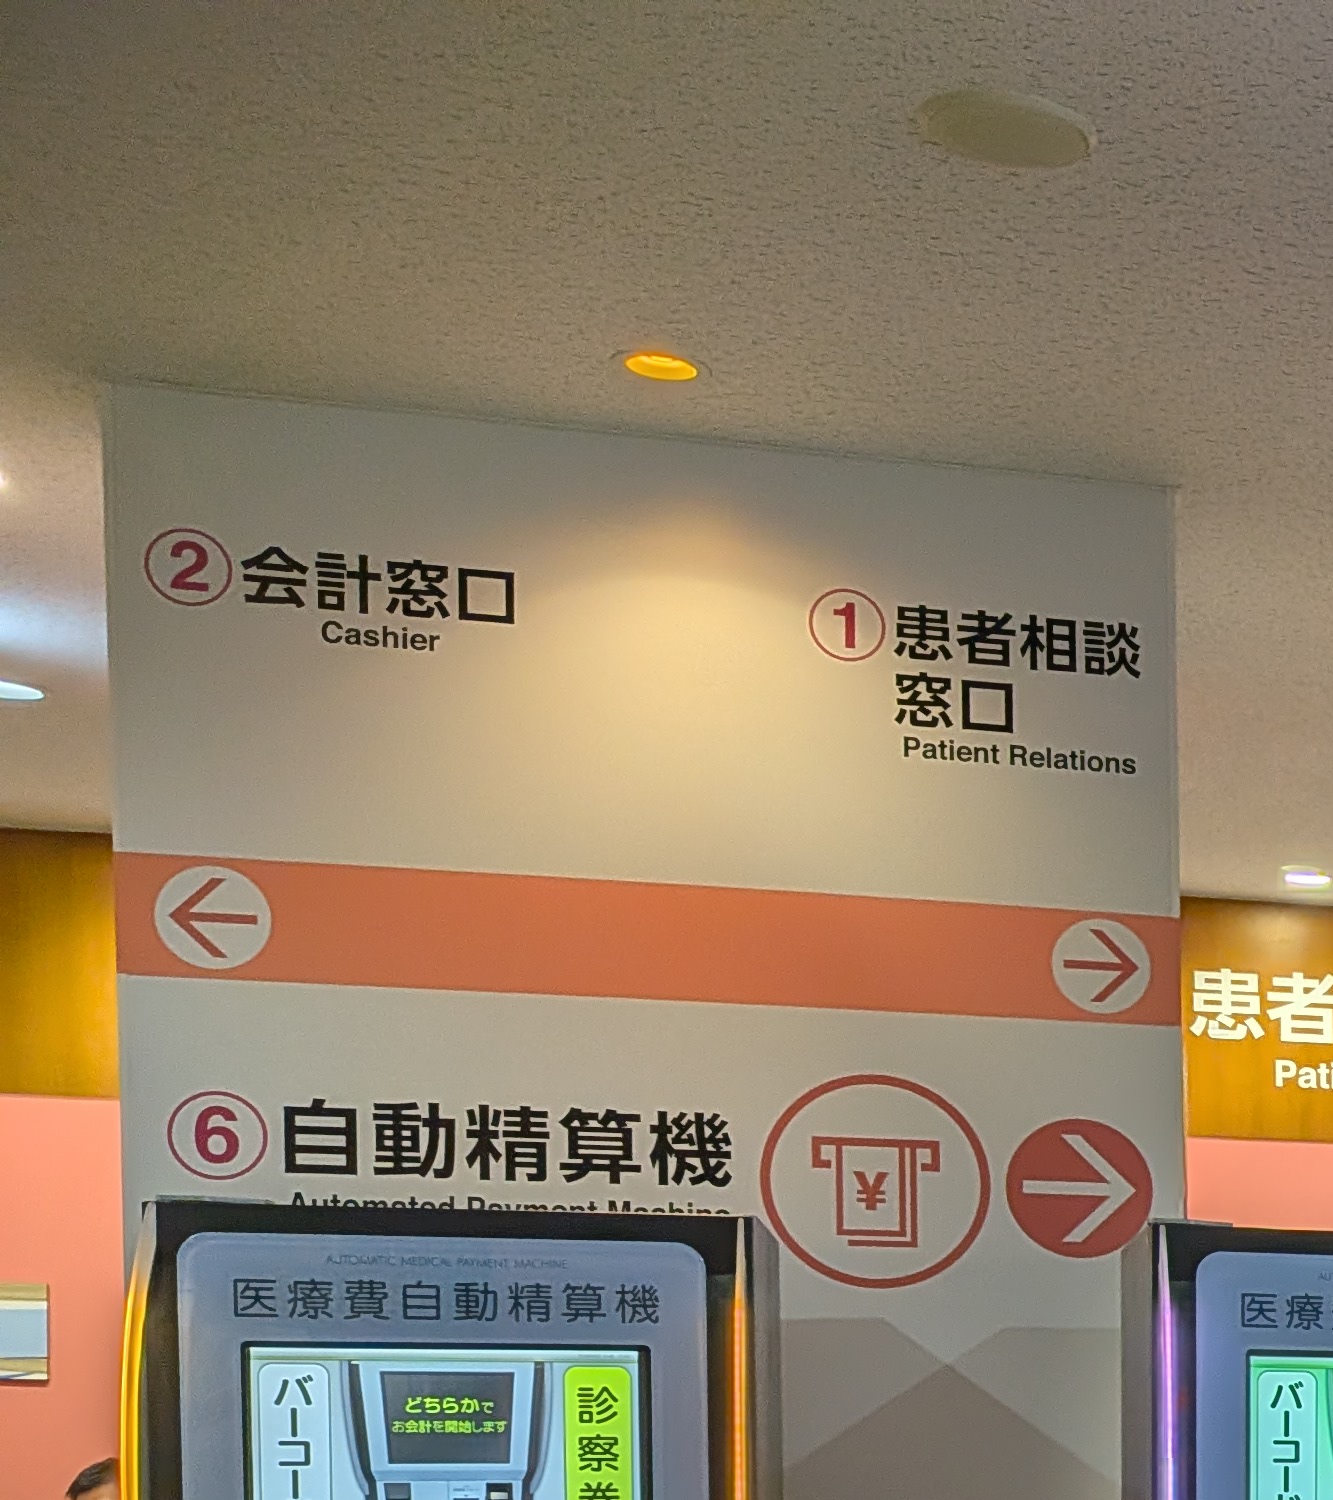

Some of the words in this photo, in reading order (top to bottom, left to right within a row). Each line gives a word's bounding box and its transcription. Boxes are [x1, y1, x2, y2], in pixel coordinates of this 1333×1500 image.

[241, 545, 516, 625] 会計窓口
[321, 620, 440, 653] Cashier
[893, 604, 1142, 679] 患者相談
[893, 672, 1015, 733] 窓口
[902, 736, 999, 765] Patient
[1009, 742, 1137, 775] Relations
[281, 1097, 734, 1189] 自動精算機
[233, 1277, 660, 1325] 医療費自動精算機
[391, 1419, 508, 1434] お会計を開始します
[404, 1396, 495, 1415] どちらかで
